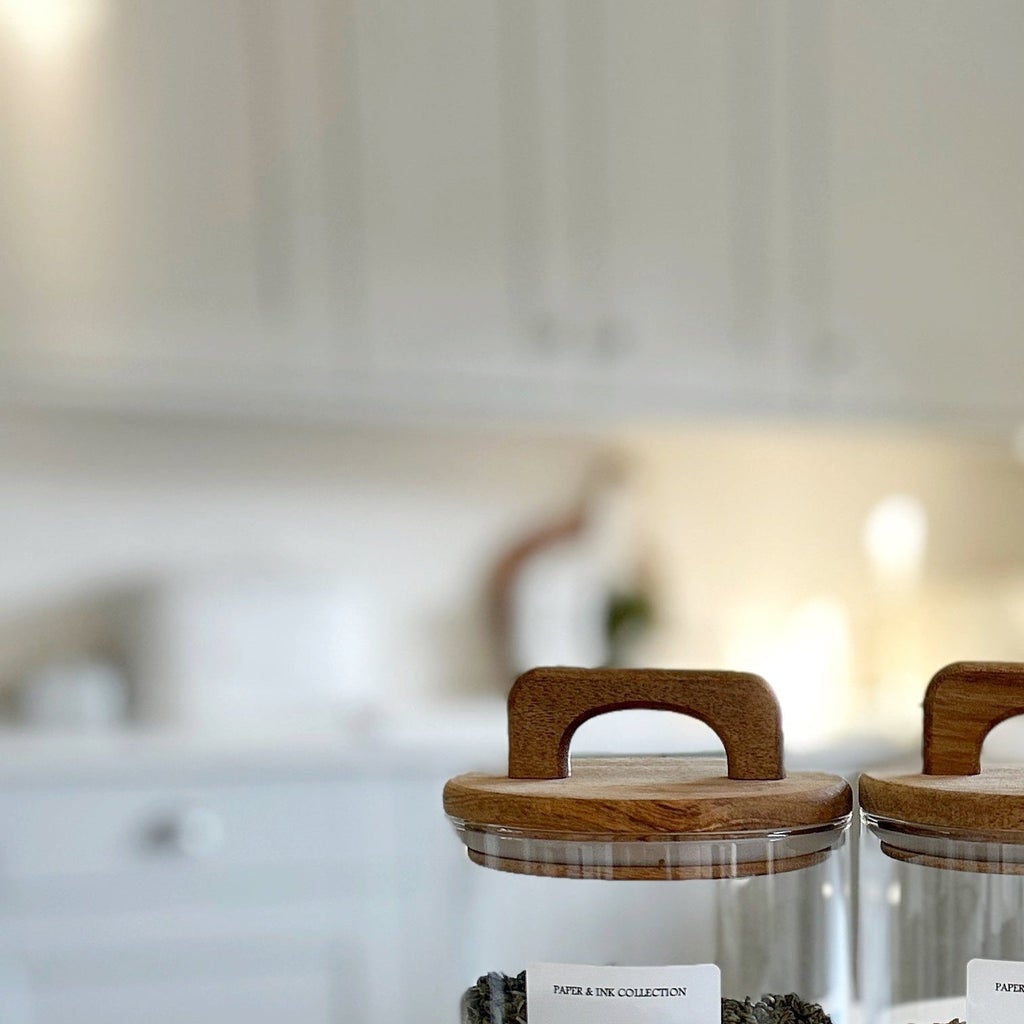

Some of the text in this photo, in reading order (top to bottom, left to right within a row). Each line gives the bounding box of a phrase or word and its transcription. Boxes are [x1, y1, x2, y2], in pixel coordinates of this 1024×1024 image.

[553, 984, 688, 998] PAPER & INK COLLECTION
